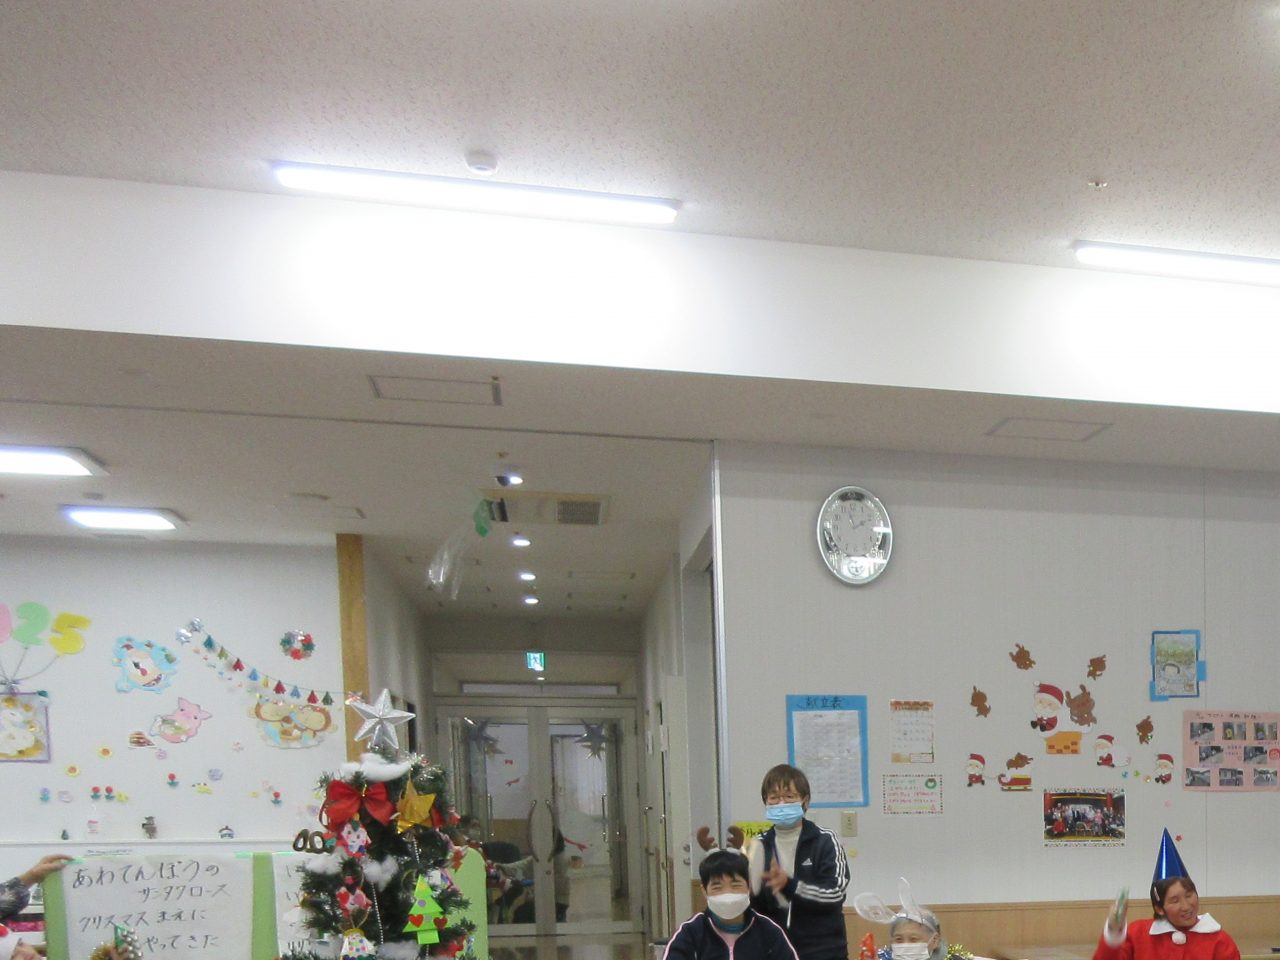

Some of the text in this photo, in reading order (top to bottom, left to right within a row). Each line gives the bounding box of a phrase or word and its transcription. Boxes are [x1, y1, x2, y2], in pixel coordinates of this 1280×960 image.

[72, 859, 220, 888] あわてんぼうの
[137, 884, 231, 903] サンタクロース
[144, 934, 220, 952] やってきた
